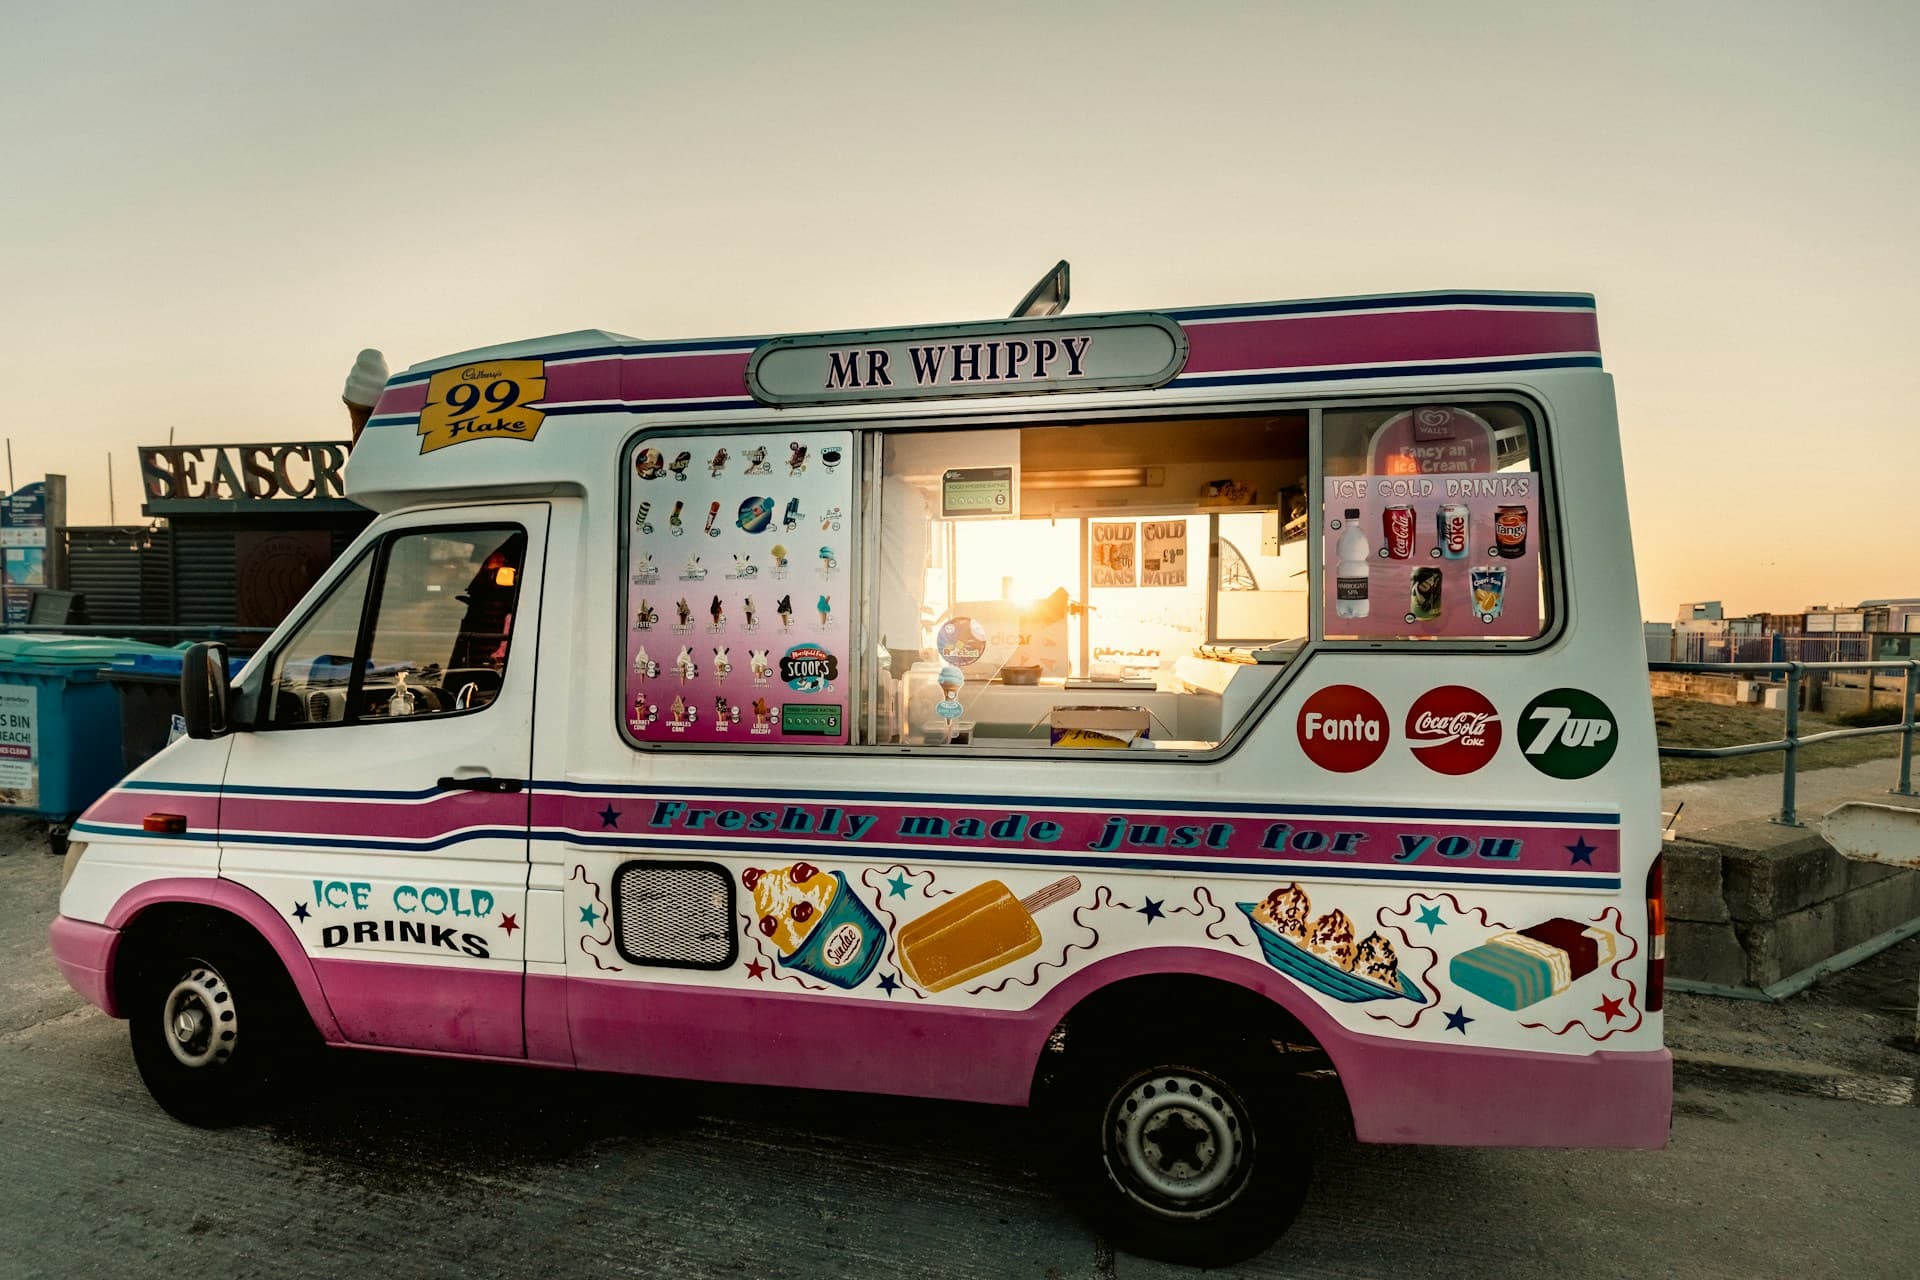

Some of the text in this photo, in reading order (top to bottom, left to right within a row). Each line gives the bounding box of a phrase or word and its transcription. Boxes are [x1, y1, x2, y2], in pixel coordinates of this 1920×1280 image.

[825, 335, 1092, 389] MR WHIPPY
[446, 379, 520, 417] 99
[445, 416, 528, 439] Flake
[1400, 445, 1467, 460] Fancy an
[1394, 460, 1416, 473] Ice
[1332, 478, 1530, 498] ICE COLD DRINKS
[997, 495, 1004, 504] 5
[1094, 525, 1133, 542] COLD
[1144, 523, 1186, 541] COLD
[1448, 517, 1465, 553] Coke
[1496, 522, 1526, 538] Tango
[1094, 568, 1134, 585] CANS
[1144, 569, 1185, 585] WATER
[788, 660, 830, 677] SCOOP'S
[10, 714, 30, 728] BIN
[828, 717, 835, 727] 5
[1305, 712, 1380, 742] Fanta
[1415, 710, 1488, 736] Coca-Cola
[1461, 736, 1486, 746] Coke
[649, 801, 1523, 863] Freshly made just for you
[313, 880, 494, 918] ICE COLD
[322, 920, 490, 959] DRINKS
[827, 929, 856, 965] Sundae
